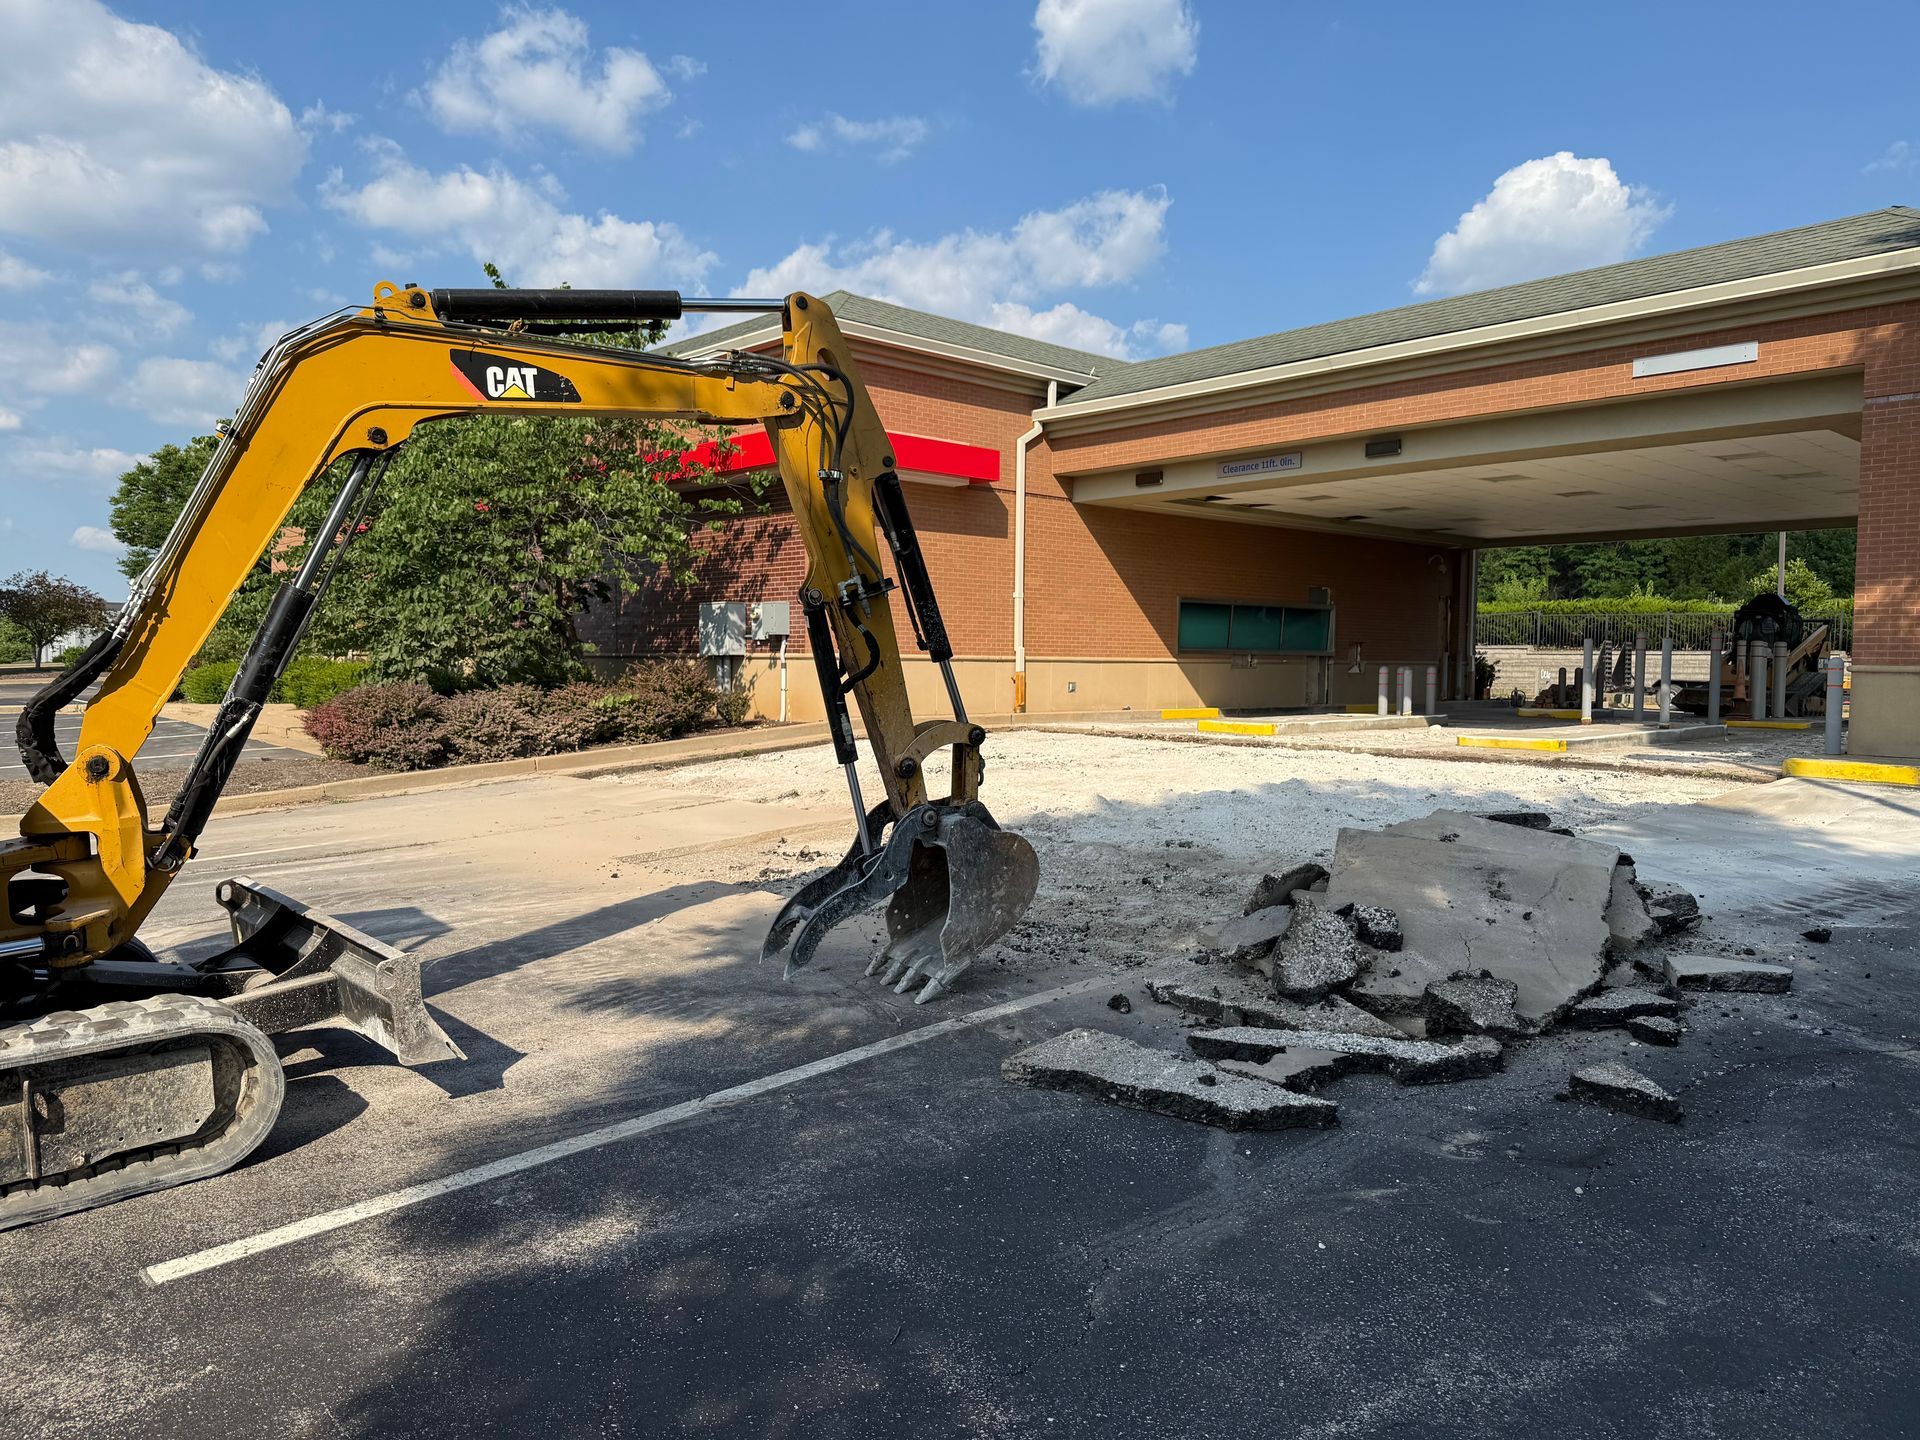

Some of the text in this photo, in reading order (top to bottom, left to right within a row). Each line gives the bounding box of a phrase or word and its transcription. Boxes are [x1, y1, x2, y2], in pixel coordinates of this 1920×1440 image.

[486, 366, 538, 399] CAT
[1222, 457, 1295, 474] Clearance 11ft. 0in.
